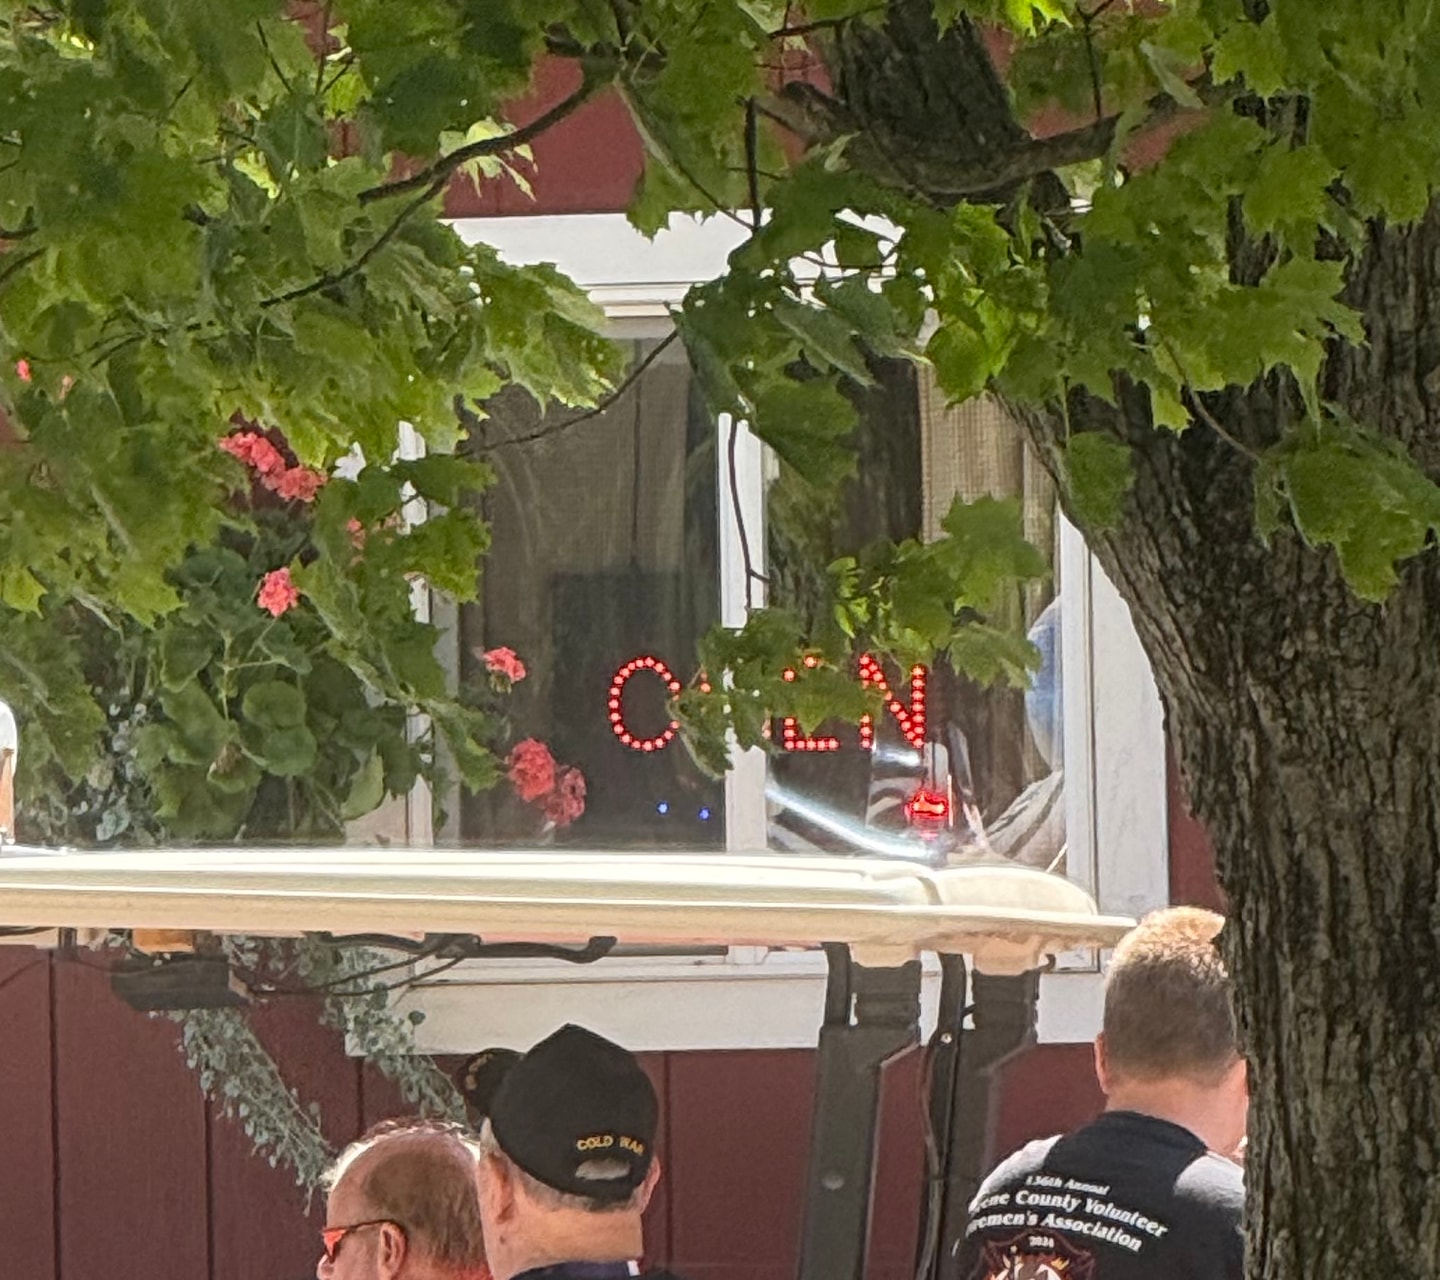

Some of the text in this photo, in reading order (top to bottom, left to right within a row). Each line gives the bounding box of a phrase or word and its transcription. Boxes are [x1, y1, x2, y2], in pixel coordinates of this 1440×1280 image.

[576, 1135, 614, 1151] COLD
[1016, 1190, 1081, 1213] County
[1085, 1198, 1169, 1238] Volunteer
[1041, 1213, 1143, 1253] Association
